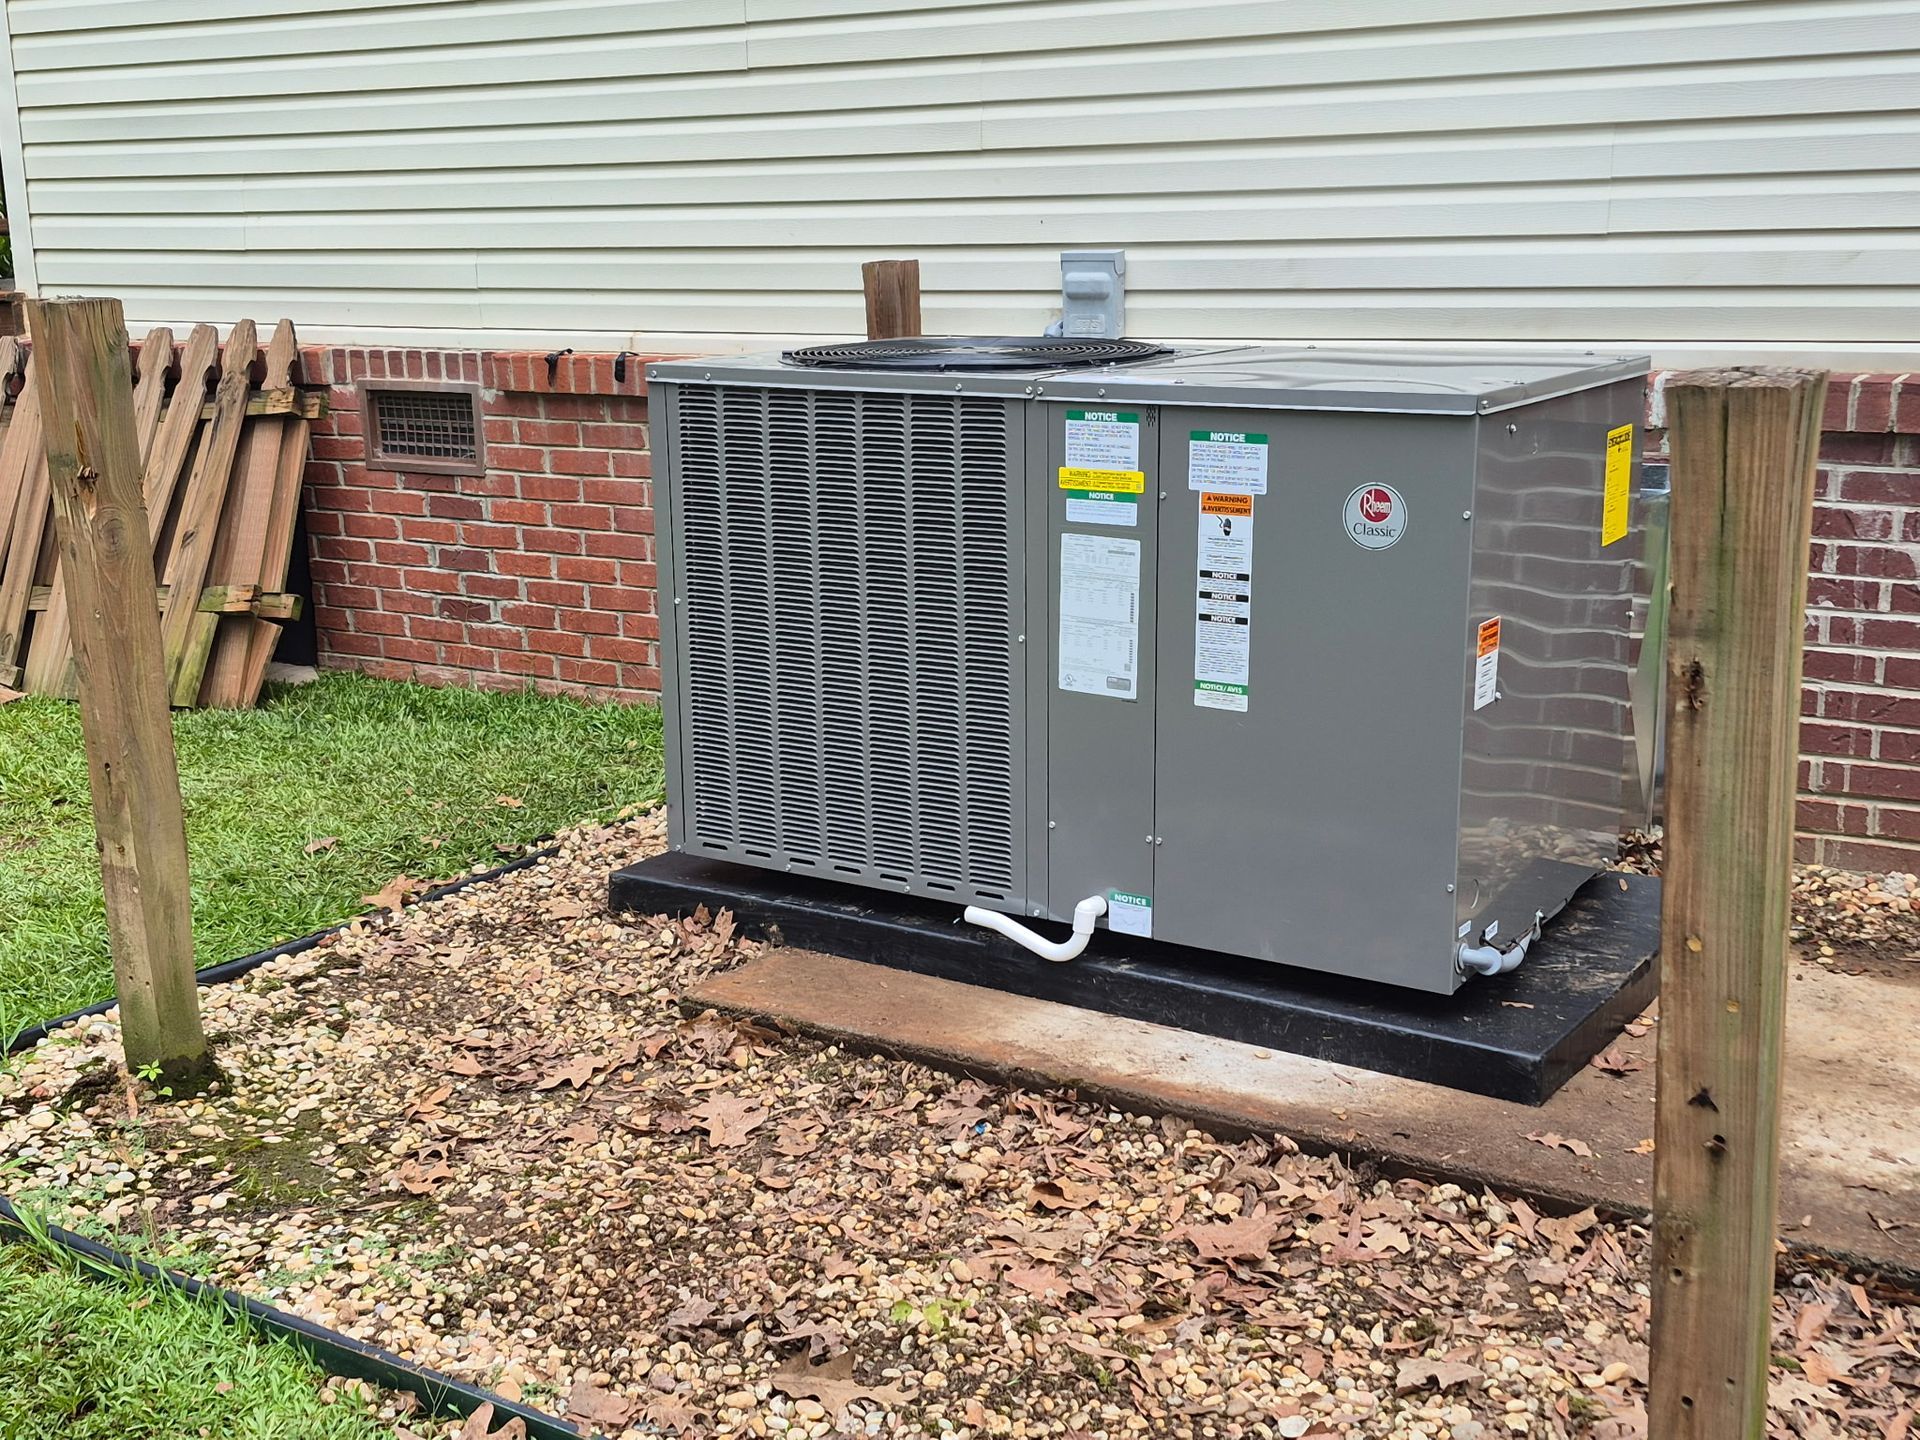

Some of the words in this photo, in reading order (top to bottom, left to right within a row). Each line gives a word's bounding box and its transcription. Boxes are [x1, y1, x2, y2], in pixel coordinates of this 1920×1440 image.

[1084, 412, 1118, 422] NOTICE
[1210, 432, 1246, 442] NOTICE
[1088, 492, 1114, 500] NOTICE
[1214, 495, 1248, 504] WARNING
[1363, 489, 1391, 517] Rheem
[1354, 522, 1396, 538] Classic
[1212, 593, 1236, 601] NOTICE
[1211, 615, 1236, 624] NOTICE
[1114, 894, 1146, 905] NOTICE
